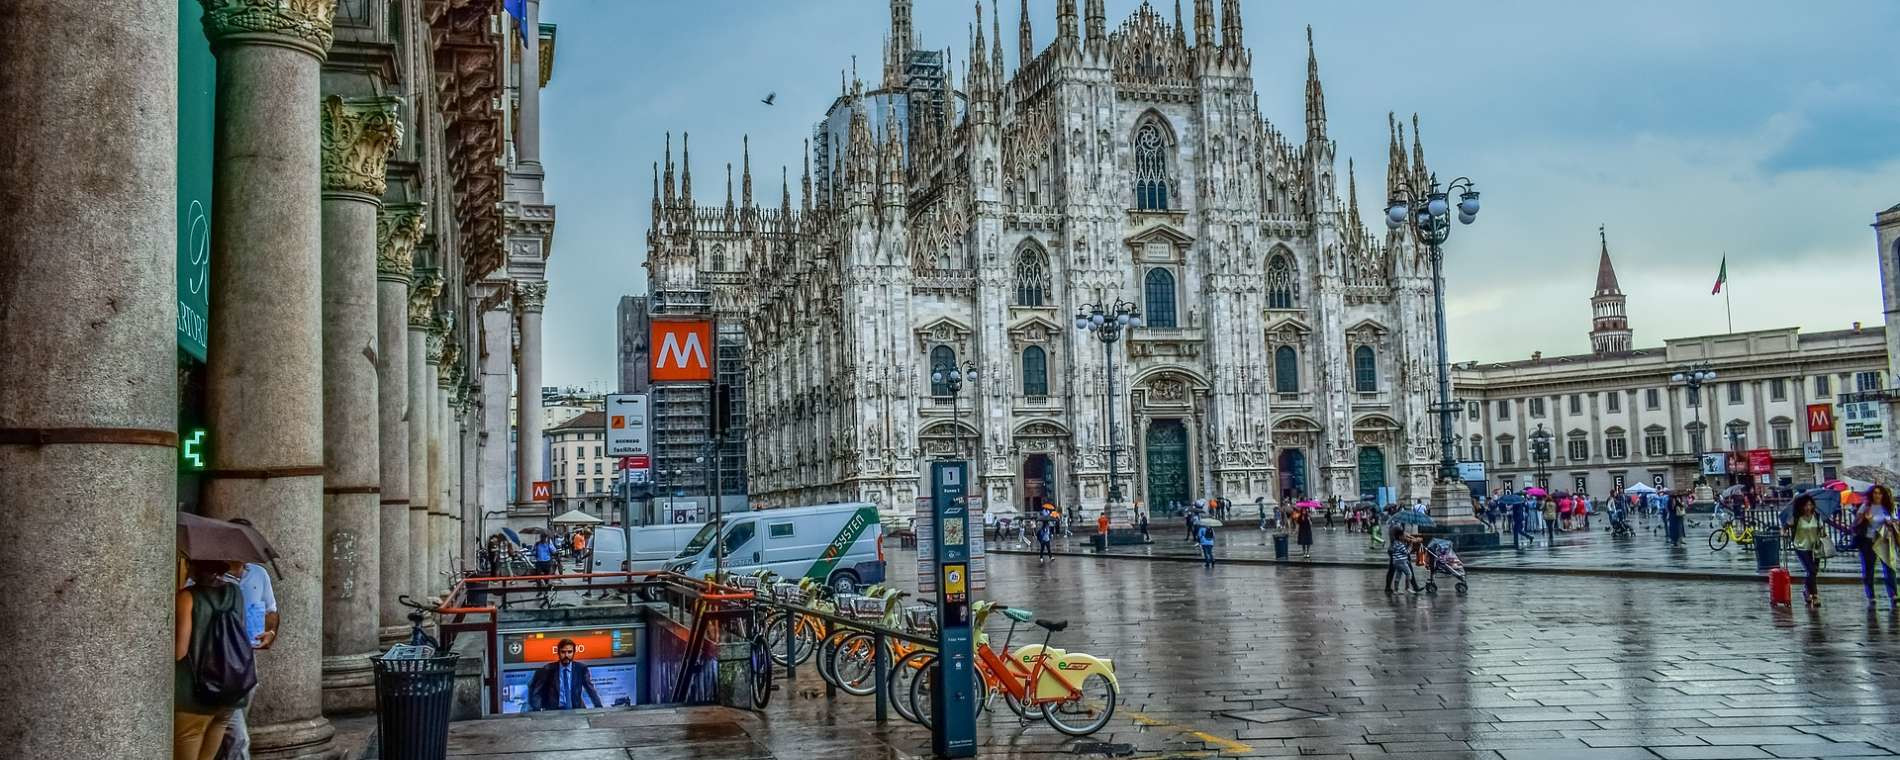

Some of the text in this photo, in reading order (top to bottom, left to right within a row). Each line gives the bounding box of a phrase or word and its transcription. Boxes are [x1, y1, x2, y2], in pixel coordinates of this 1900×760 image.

[656, 332, 708, 368] M
[1811, 410, 1829, 427] M
[535, 485, 549, 497] M
